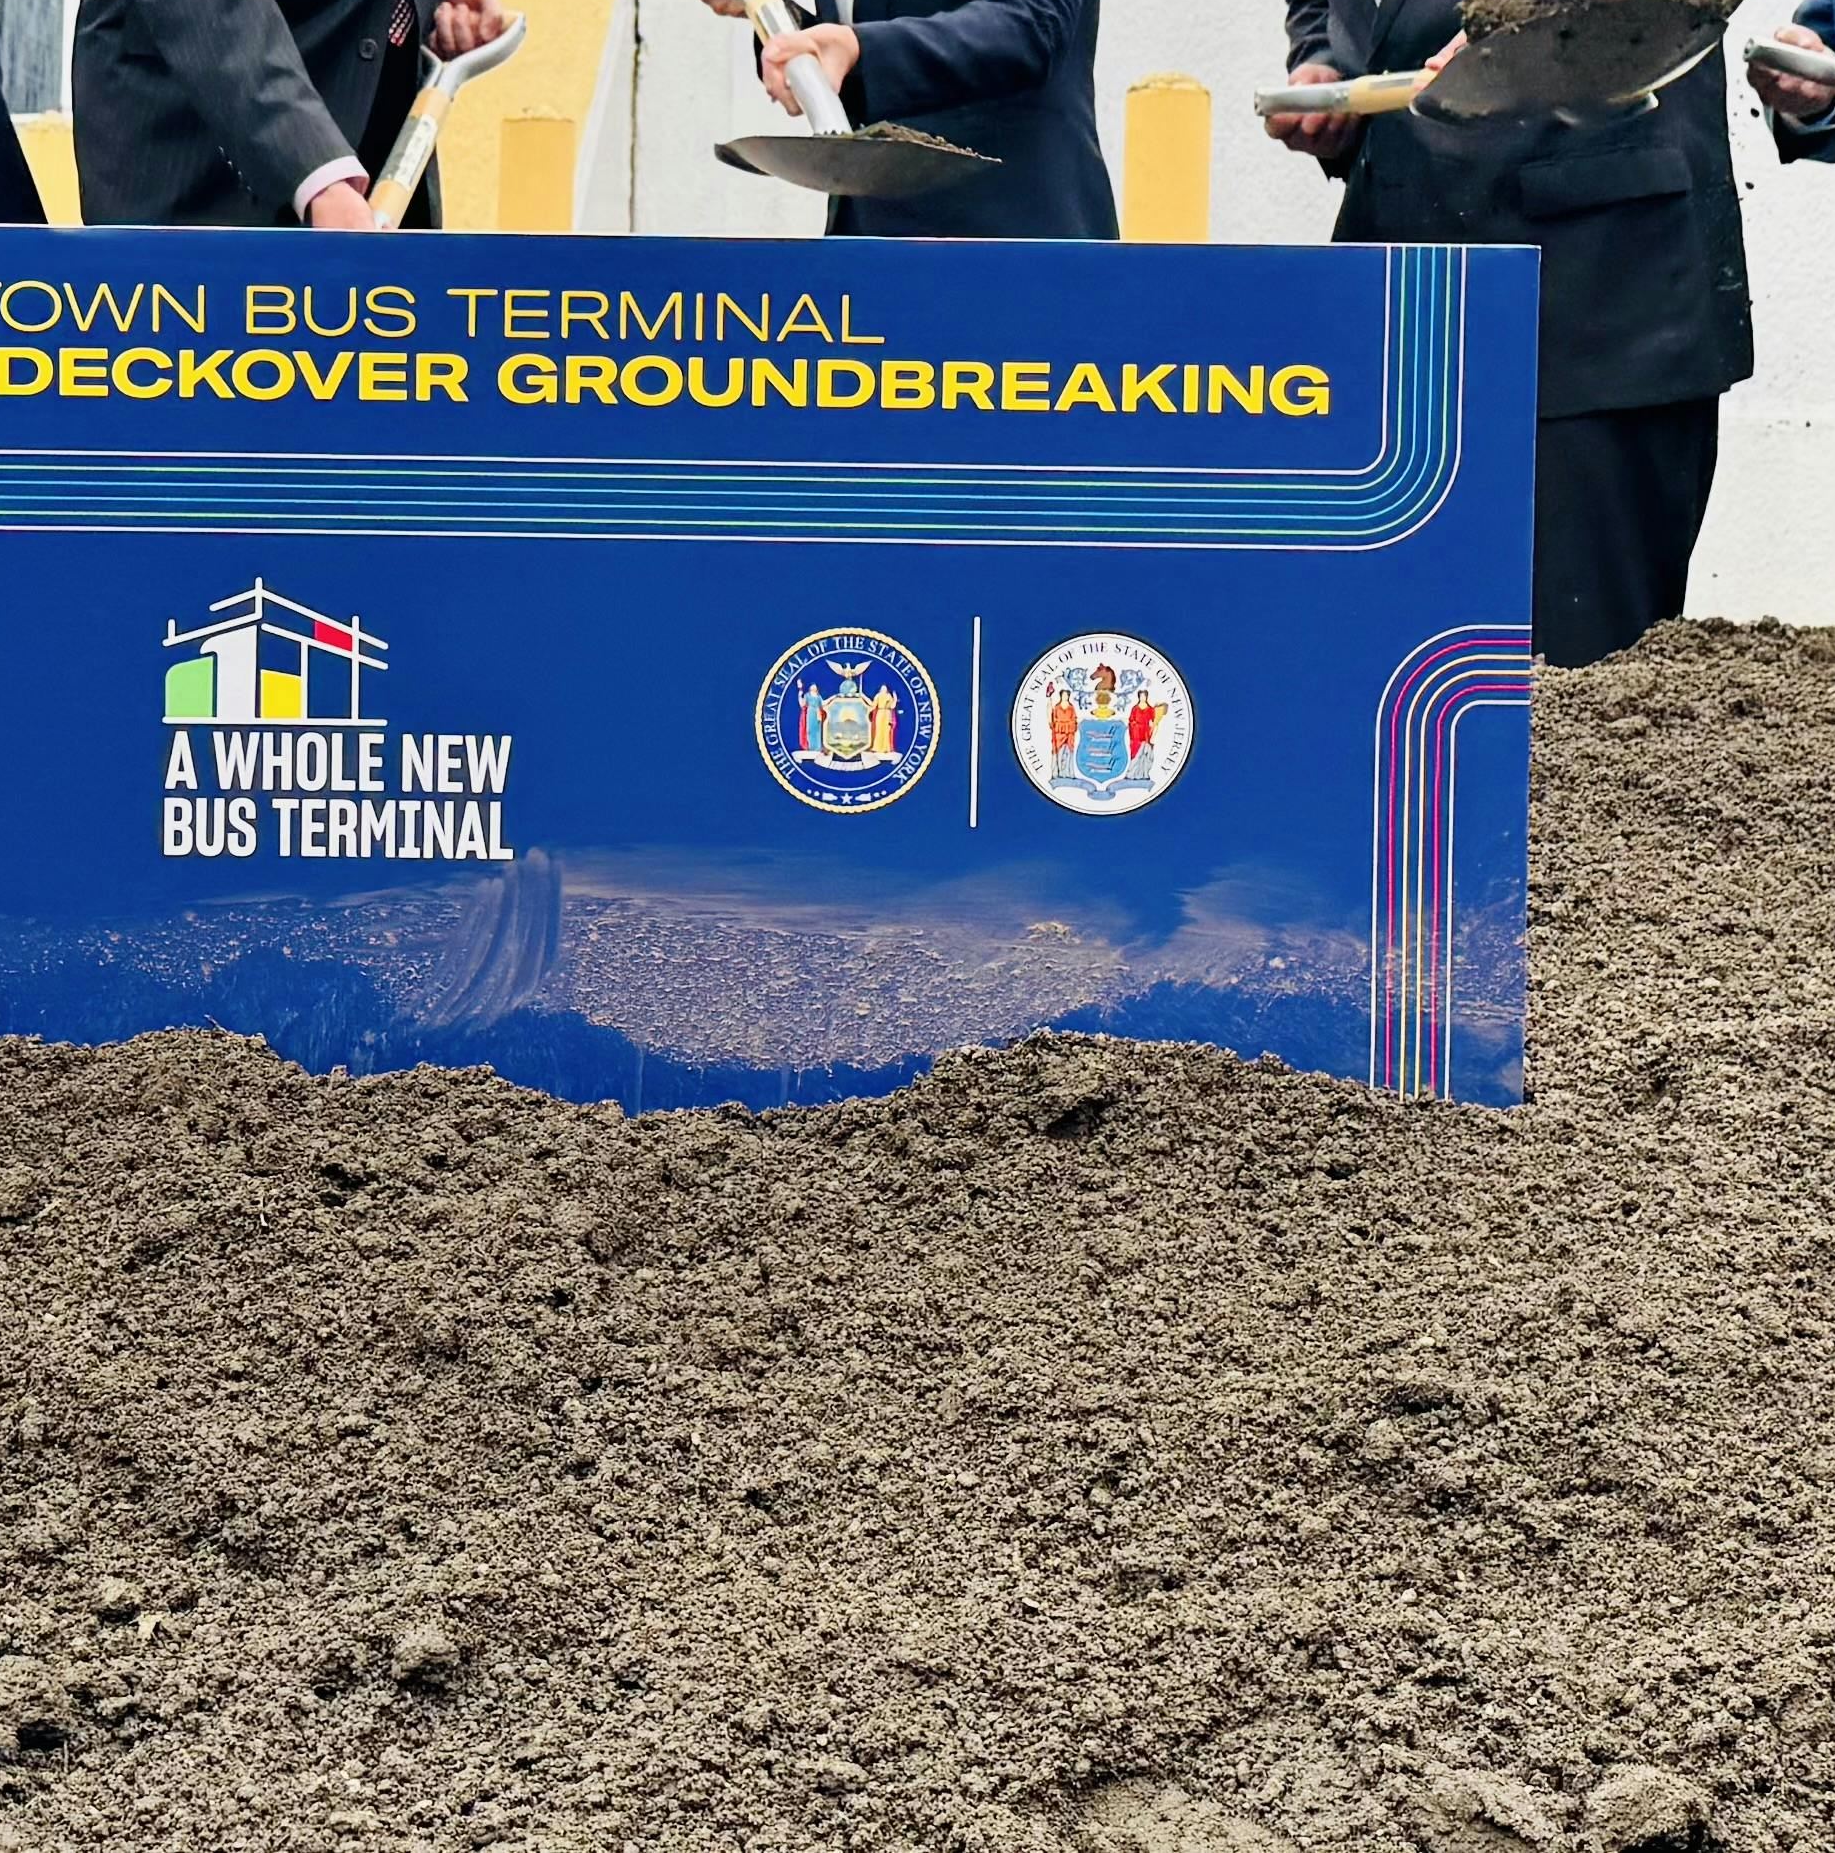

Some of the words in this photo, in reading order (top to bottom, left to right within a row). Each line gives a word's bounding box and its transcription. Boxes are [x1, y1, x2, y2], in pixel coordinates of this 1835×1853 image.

[245, 285, 416, 338] BUS
[446, 288, 885, 344] TERMINAL
[497, 354, 1330, 416] GROUNDBREAKING
[807, 641, 827, 658] OF
[833, 635, 865, 650] THE
[867, 640, 914, 678] STATE
[1058, 649, 1075, 662] OF
[1082, 641, 1109, 655] THE
[1115, 643, 1157, 669] STATE
[773, 656, 808, 689] SEAL
[910, 677, 928, 699] OF
[1031, 663, 1058, 693] SEAL
[1156, 668, 1173, 685] OF
[763, 689, 779, 746] GREAT
[919, 700, 934, 738] NEW
[1167, 686, 1185, 719] NEW
[1021, 697, 1036, 742] GREAT
[164, 730, 198, 790] A
[212, 731, 385, 792] WHOLE
[401, 733, 512, 794] NEW
[770, 747, 796, 779] THE
[893, 744, 928, 785] YORK
[1025, 746, 1044, 773] THE
[163, 797, 257, 857] BUS
[271, 798, 514, 860] TERMINAL
